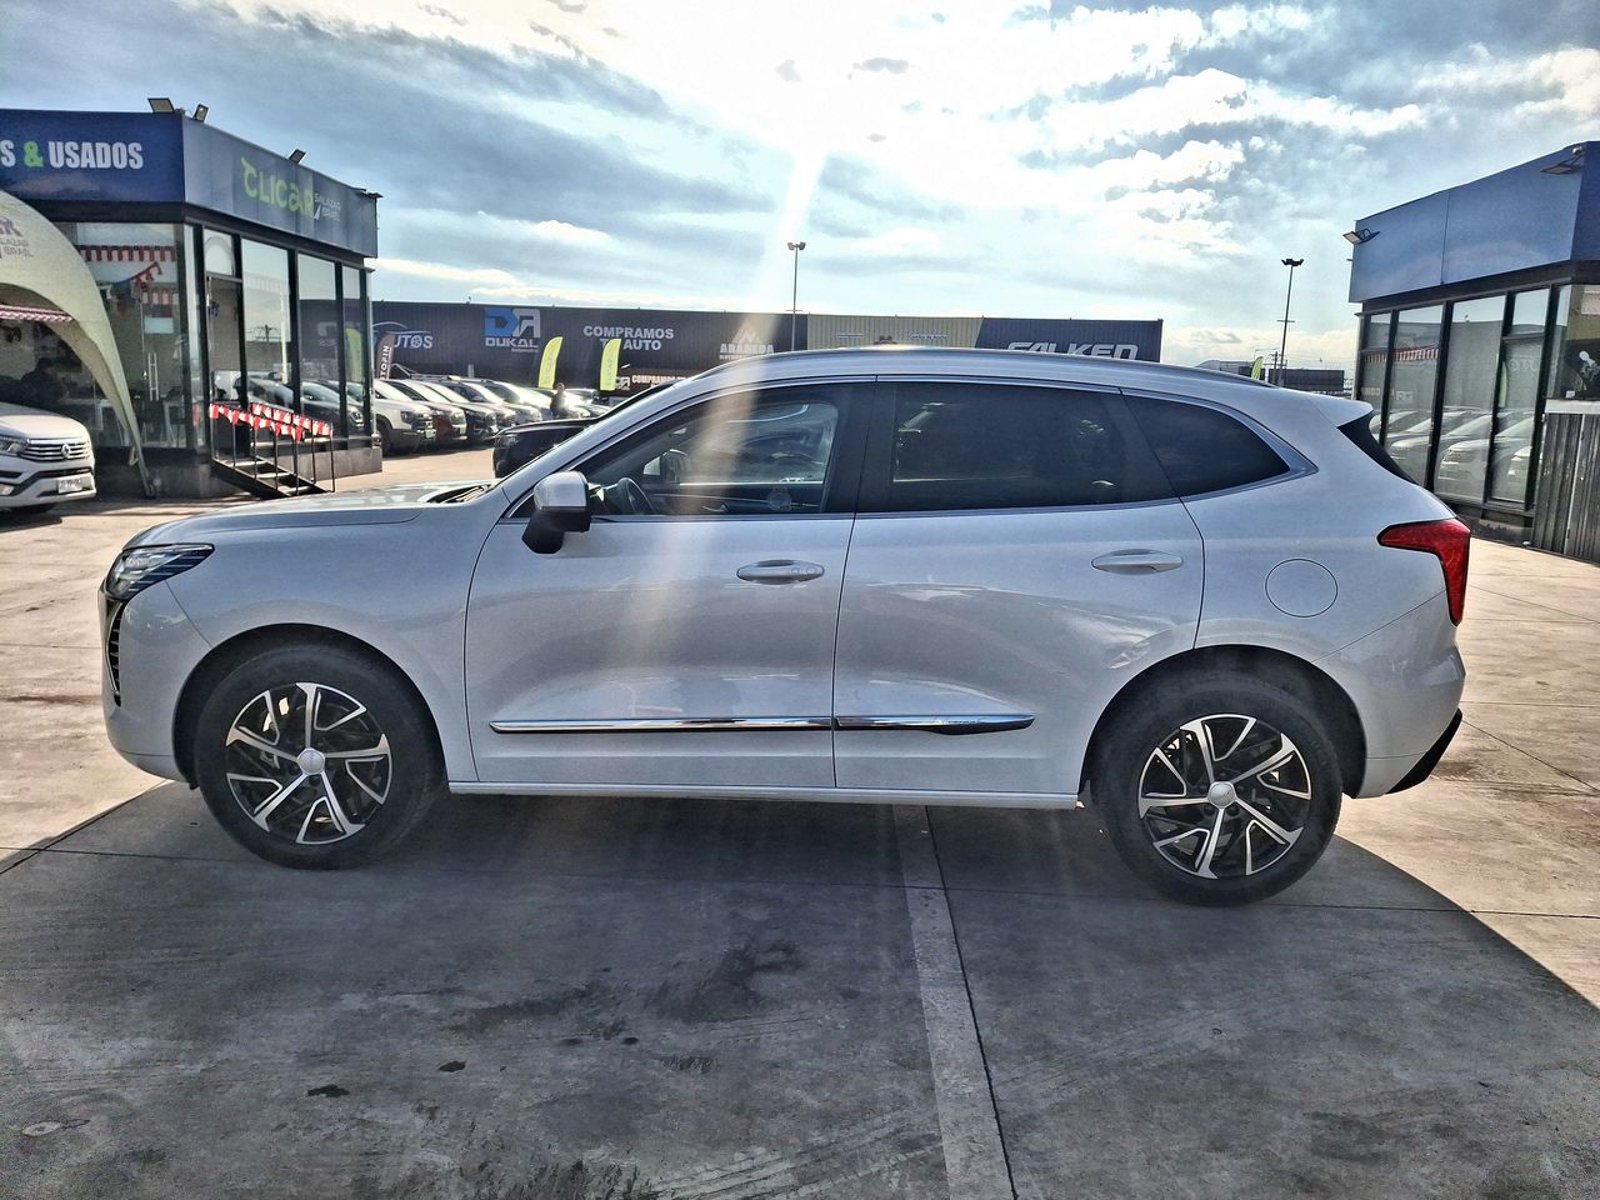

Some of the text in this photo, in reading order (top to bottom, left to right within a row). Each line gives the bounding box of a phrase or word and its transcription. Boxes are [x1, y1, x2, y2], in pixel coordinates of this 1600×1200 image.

[24, 141, 44, 168] &
[48, 141, 144, 169] USADOS
[583, 325, 674, 339] COMPRAMOS
[623, 339, 662, 351] AUTO
